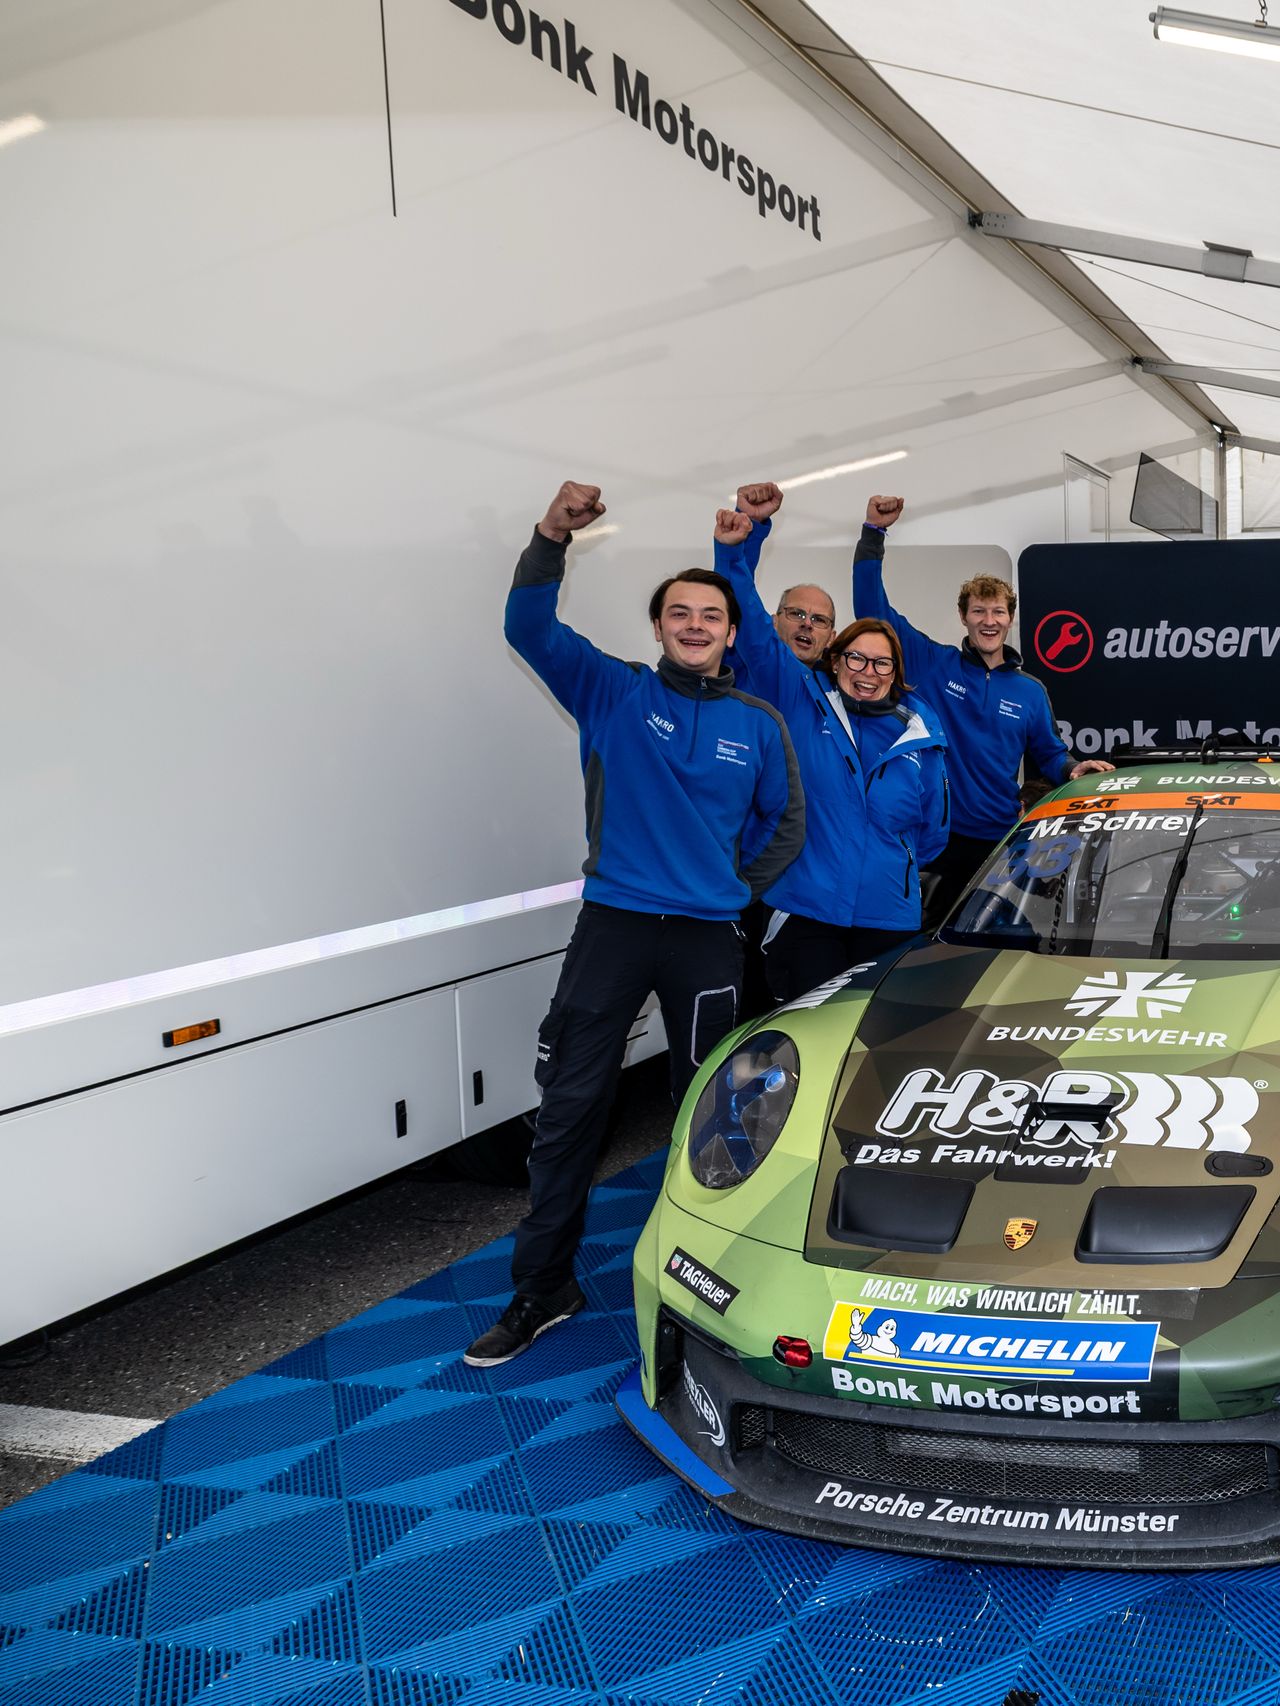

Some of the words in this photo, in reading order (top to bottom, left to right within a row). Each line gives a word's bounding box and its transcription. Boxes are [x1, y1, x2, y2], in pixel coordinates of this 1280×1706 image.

[449, 0, 598, 96] onk
[612, 53, 822, 242] Motorsport
[1055, 720, 1159, 754] Bonk
[1028, 820, 1067, 841] M.
[1078, 812, 1208, 836] Schrey
[986, 1026, 1228, 1048] BUNDESWEHR
[876, 1068, 1131, 1149] H&R
[853, 1144, 922, 1165] Das
[931, 1145, 1118, 1168] Fahrwerk!
[860, 1278, 921, 1307] MACH,
[926, 1283, 970, 1308] WAS
[975, 1286, 1073, 1314] WIRKLICH
[1077, 1288, 1143, 1316] ZÄHLT.
[911, 1331, 1126, 1362] MICHELIN
[831, 1367, 921, 1402] Bonk
[933, 1382, 1141, 1419] Motorsport
[815, 1481, 925, 1519] Porsche
[927, 1498, 1050, 1530] Zentrum
[1055, 1507, 1179, 1533] Münster
